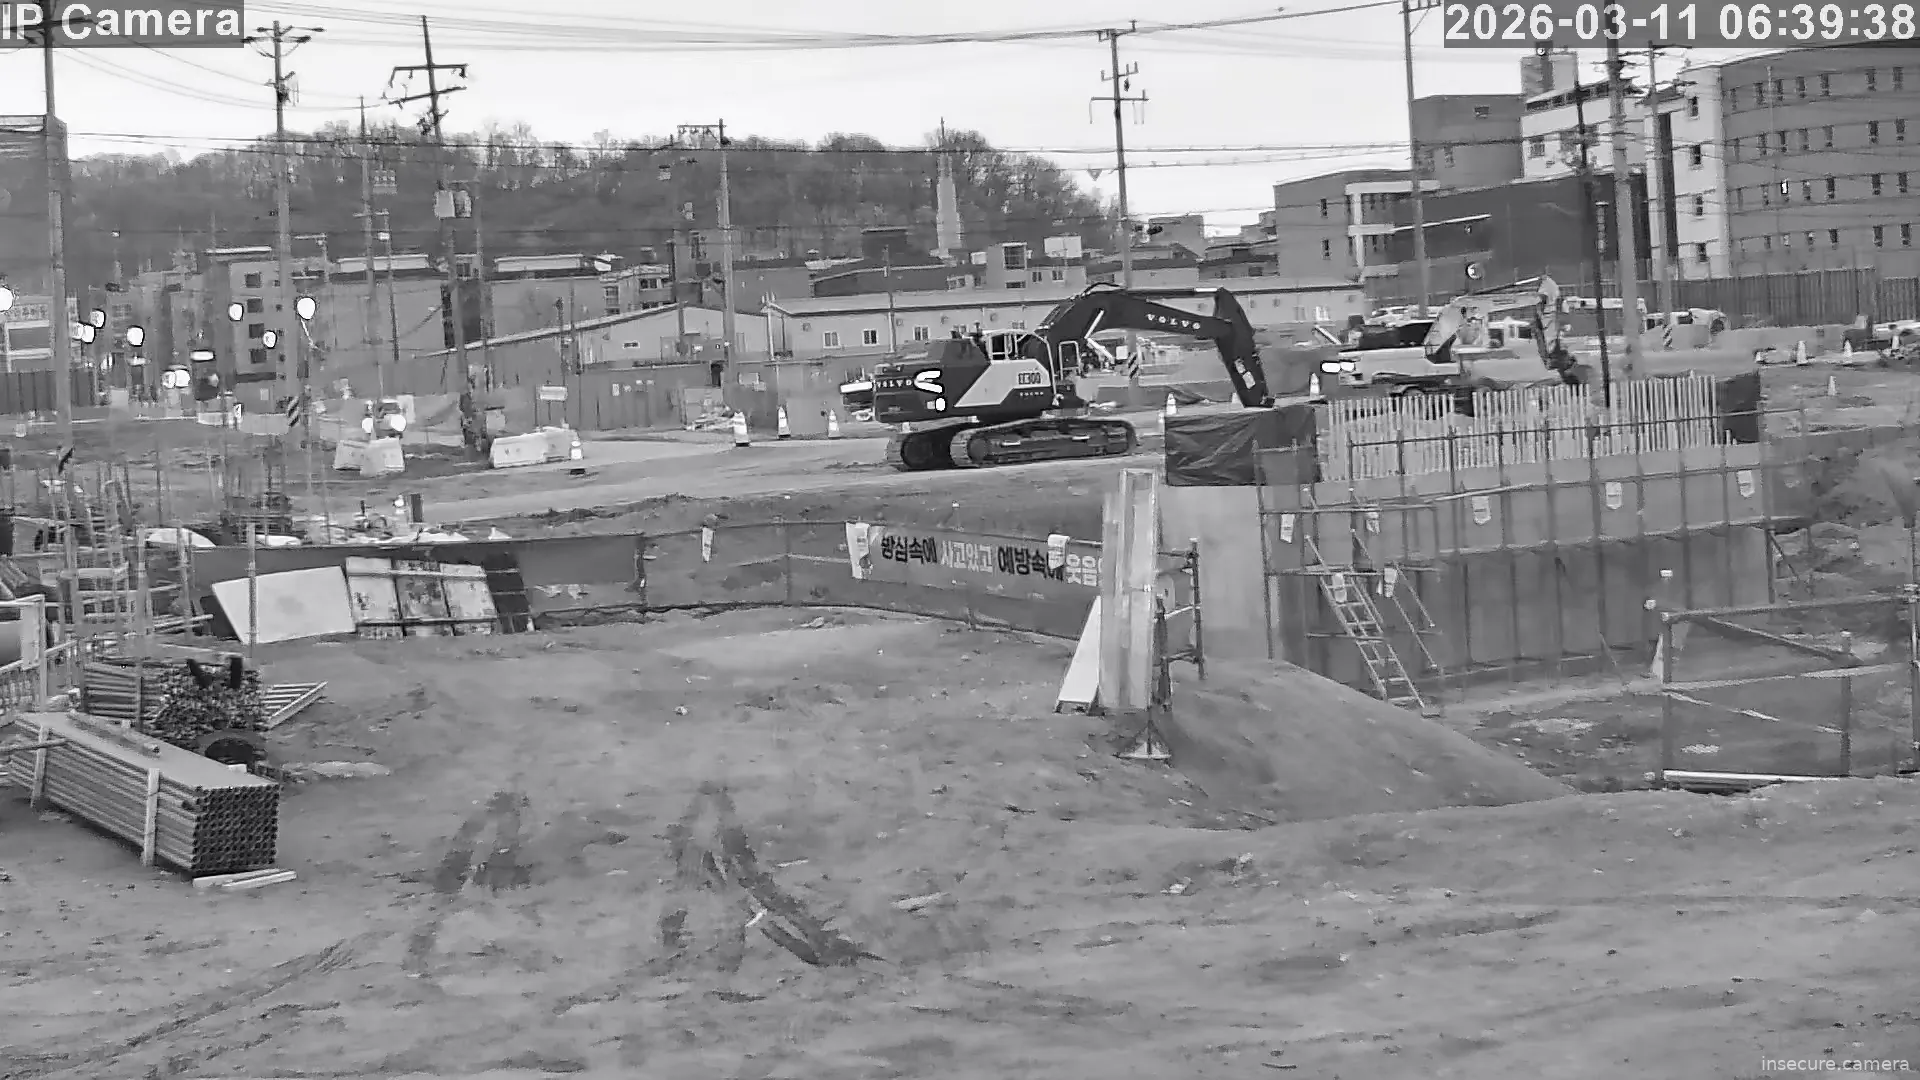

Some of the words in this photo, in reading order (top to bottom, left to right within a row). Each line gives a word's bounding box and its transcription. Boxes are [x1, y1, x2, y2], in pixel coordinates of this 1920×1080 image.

[1145, 313, 1201, 330] VOLVO
[881, 535, 938, 564] 방심속에
[1066, 553, 1102, 587] 웃음
